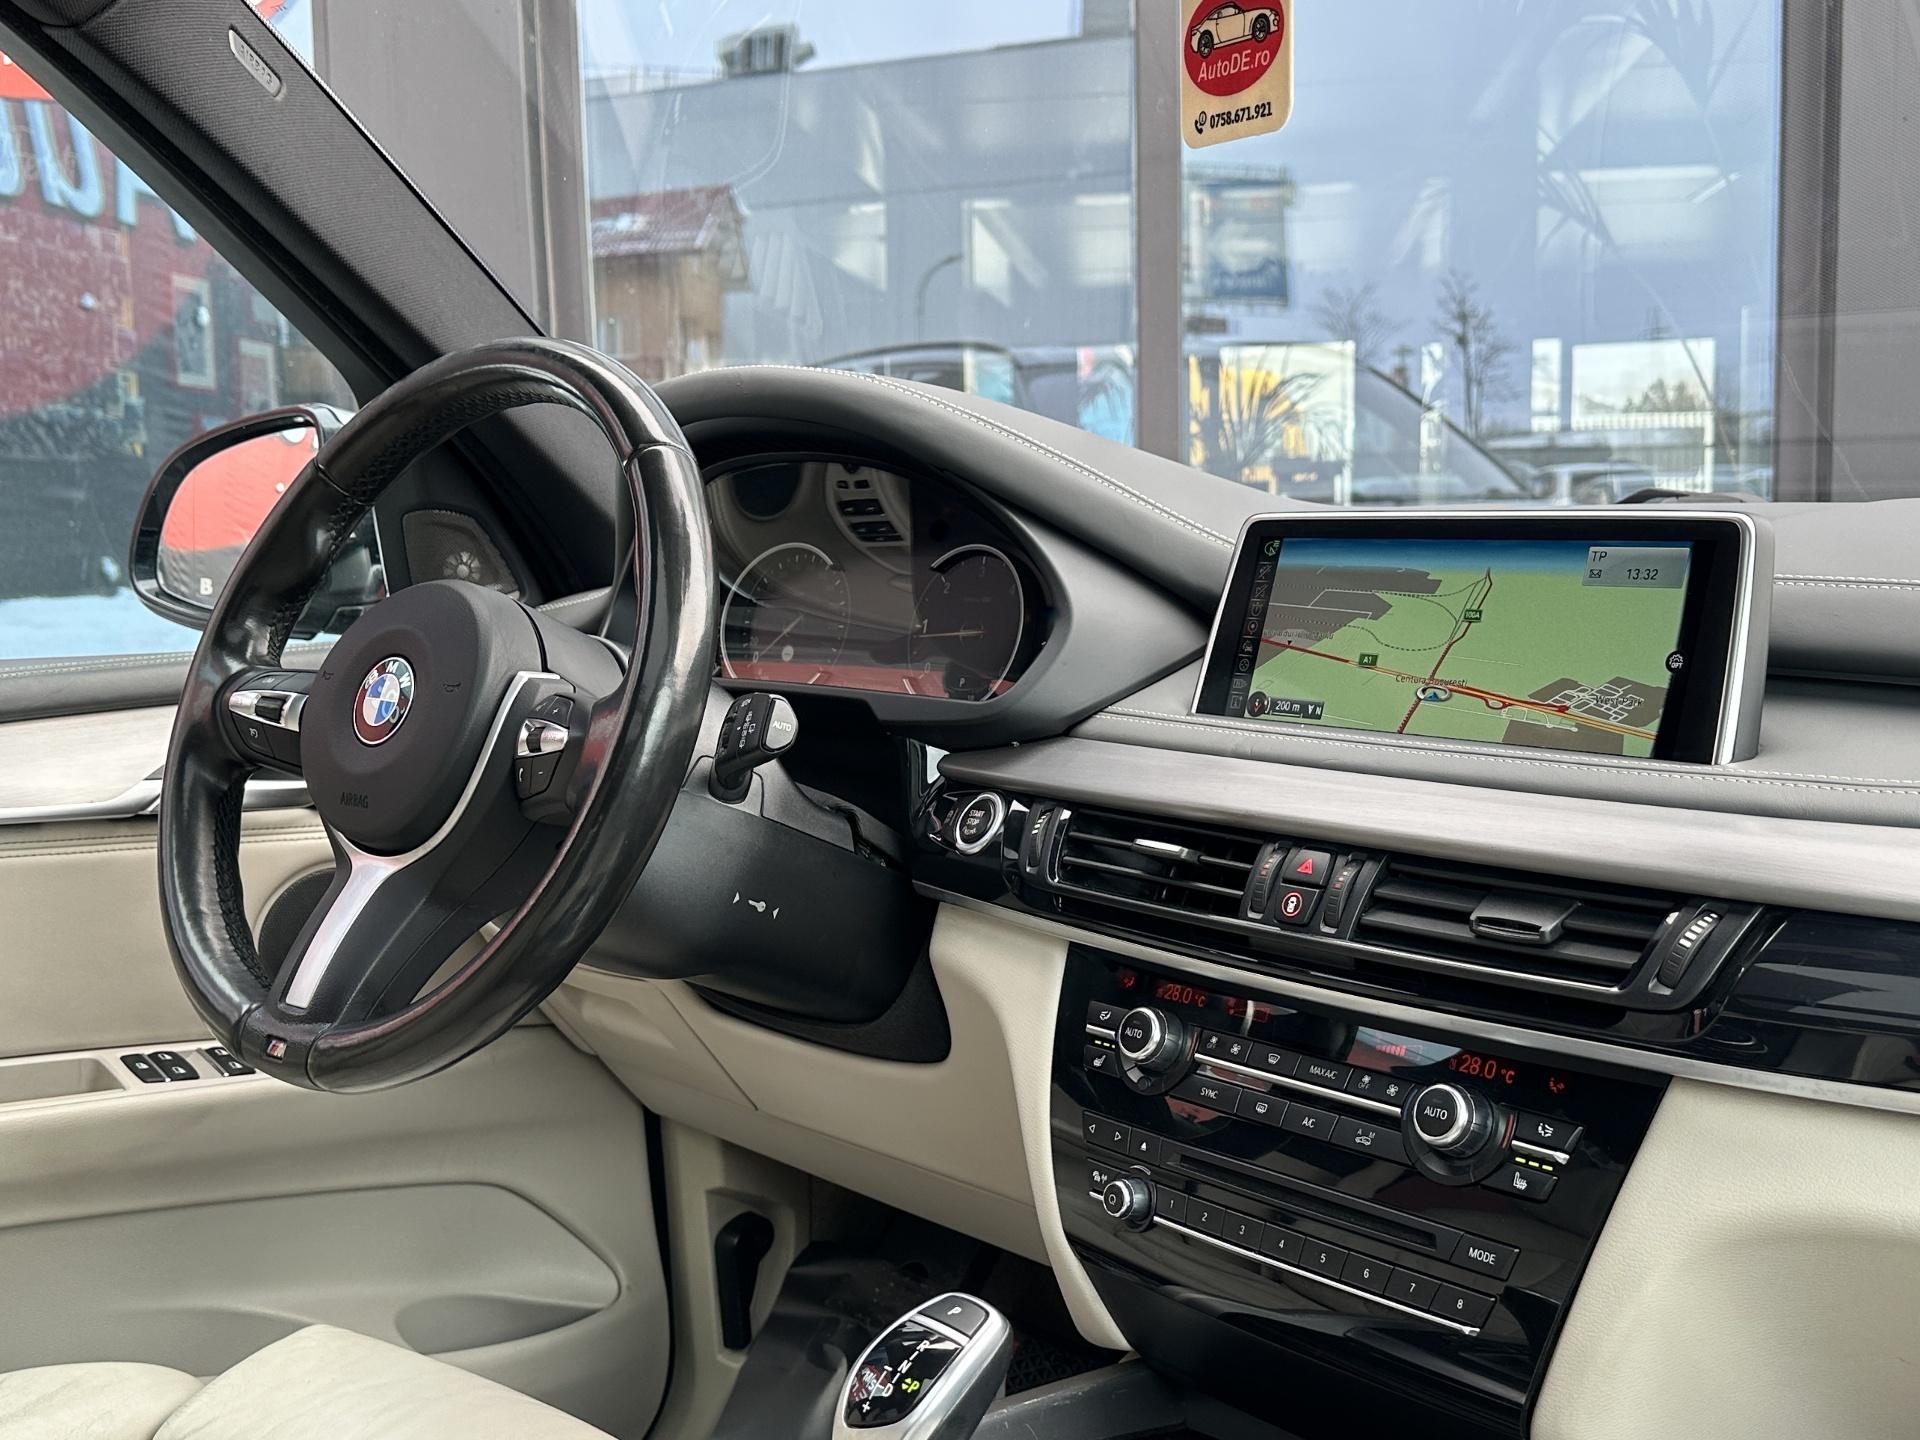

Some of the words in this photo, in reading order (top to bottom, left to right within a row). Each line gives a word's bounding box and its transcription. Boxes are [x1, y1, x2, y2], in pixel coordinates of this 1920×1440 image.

[1197, 50, 1270, 82] AutoDE.ro
[1209, 102, 1272, 129] 0758.671.921
[1591, 551, 1607, 562] TP
[1626, 568, 1658, 580] 13:32
[922, 618, 929, 634] 1
[1362, 656, 1372, 664] A1
[366, 660, 411, 690] BMW
[1275, 701, 1291, 711] 200
[1292, 703, 1300, 712] m
[1315, 706, 1322, 715] N
[772, 720, 792, 732] AUTO
[340, 791, 368, 809] AIRBAG
[969, 810, 985, 818] START
[1164, 983, 1193, 1004] 28.0
[1124, 1026, 1143, 1039] AUTO
[1459, 1054, 1497, 1080] 28.0
[1200, 1087, 1219, 1100] SYNC
[1423, 1105, 1448, 1121] AUTO
[1301, 1116, 1316, 1129] A/C
[1170, 1199, 1174, 1209] 1
[1201, 1212, 1208, 1222] 2
[1239, 1224, 1246, 1235] 3
[1278, 1239, 1285, 1249] 4
[1320, 1253, 1327, 1263] 5
[1468, 1246, 1497, 1265] MODE
[1363, 1268, 1370, 1279] 6
[1409, 1282, 1416, 1293] 7
[1456, 1298, 1464, 1310] 8
[947, 1306, 962, 1315] P
[916, 1339, 931, 1353] R
[897, 1359, 913, 1374] N
[881, 1384, 894, 1398] D
[907, 1380, 920, 1393] P
